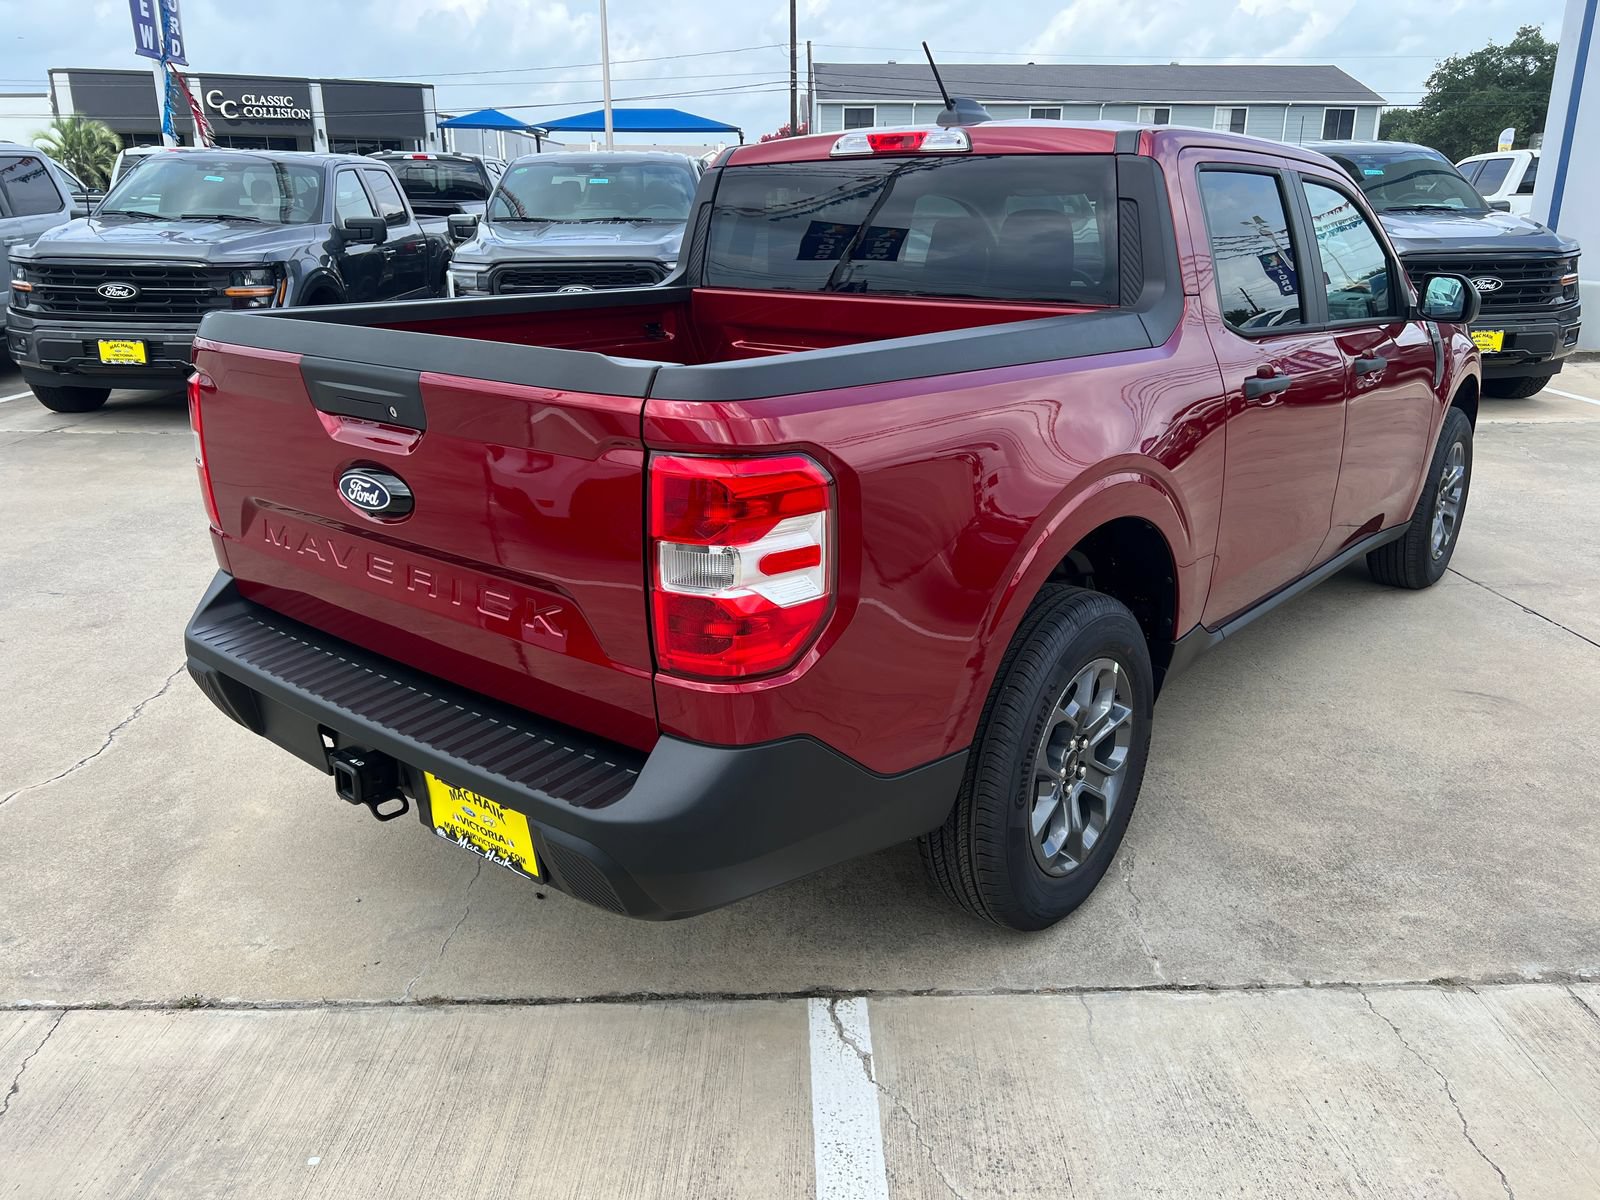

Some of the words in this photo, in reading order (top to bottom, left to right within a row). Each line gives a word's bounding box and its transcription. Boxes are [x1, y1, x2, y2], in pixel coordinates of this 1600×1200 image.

[241, 94, 294, 107] CLASSIC
[243, 106, 311, 119] COLLISION
[105, 285, 129, 297] Ford
[348, 477, 380, 506] Ford
[264, 518, 563, 638] MAVERICK
[449, 788, 471, 803] MAC
[473, 793, 506, 825] HAIK
[459, 815, 507, 845] VICTORIA
[457, 835, 483, 856] Mac
